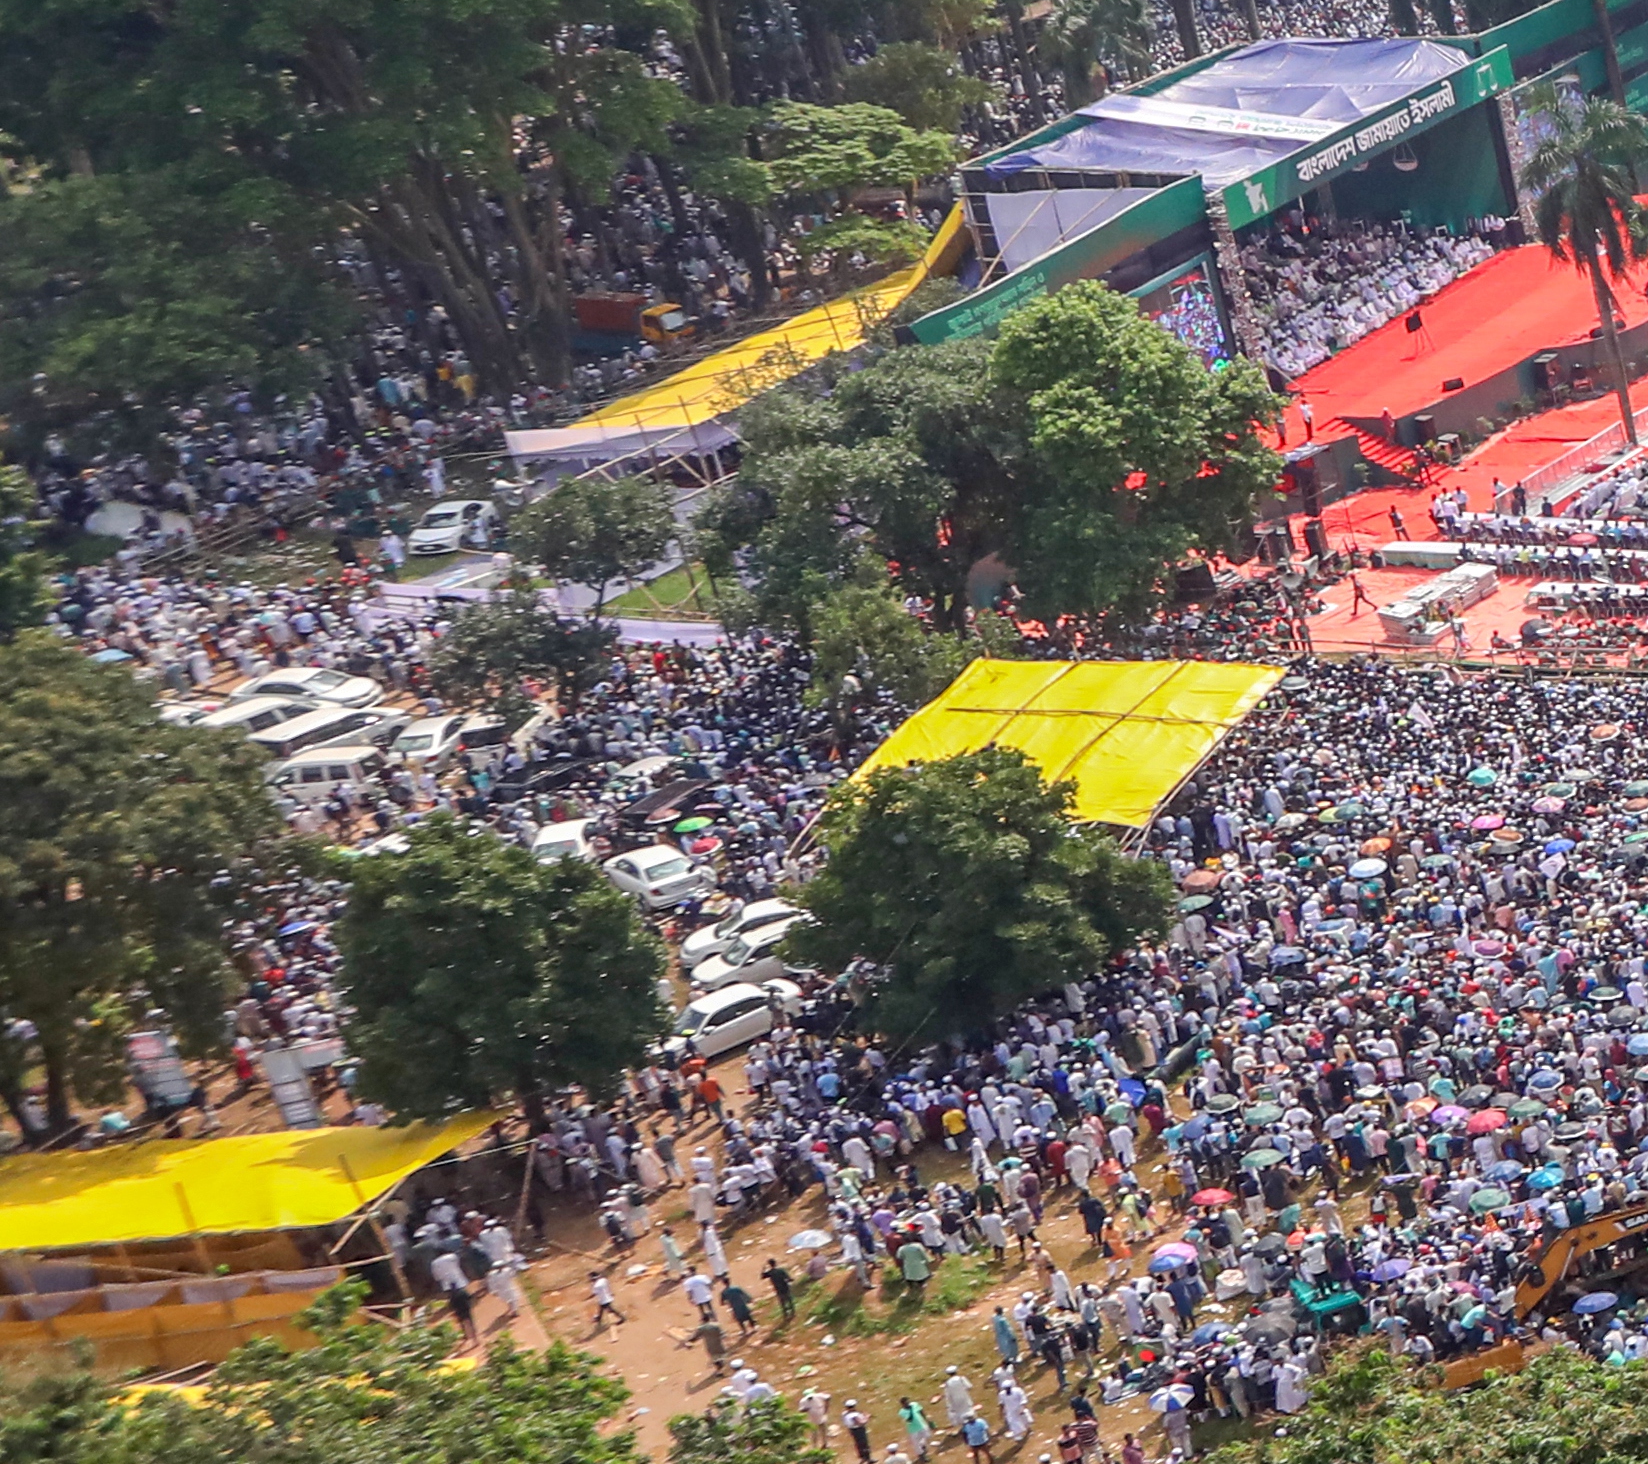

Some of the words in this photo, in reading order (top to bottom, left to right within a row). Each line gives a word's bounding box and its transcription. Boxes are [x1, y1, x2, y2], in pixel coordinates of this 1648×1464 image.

[1296, 137, 1357, 182] বাংলাদেশ
[1355, 107, 1412, 153] জামায়াতে
[1408, 80, 1456, 125] ইসলামী
